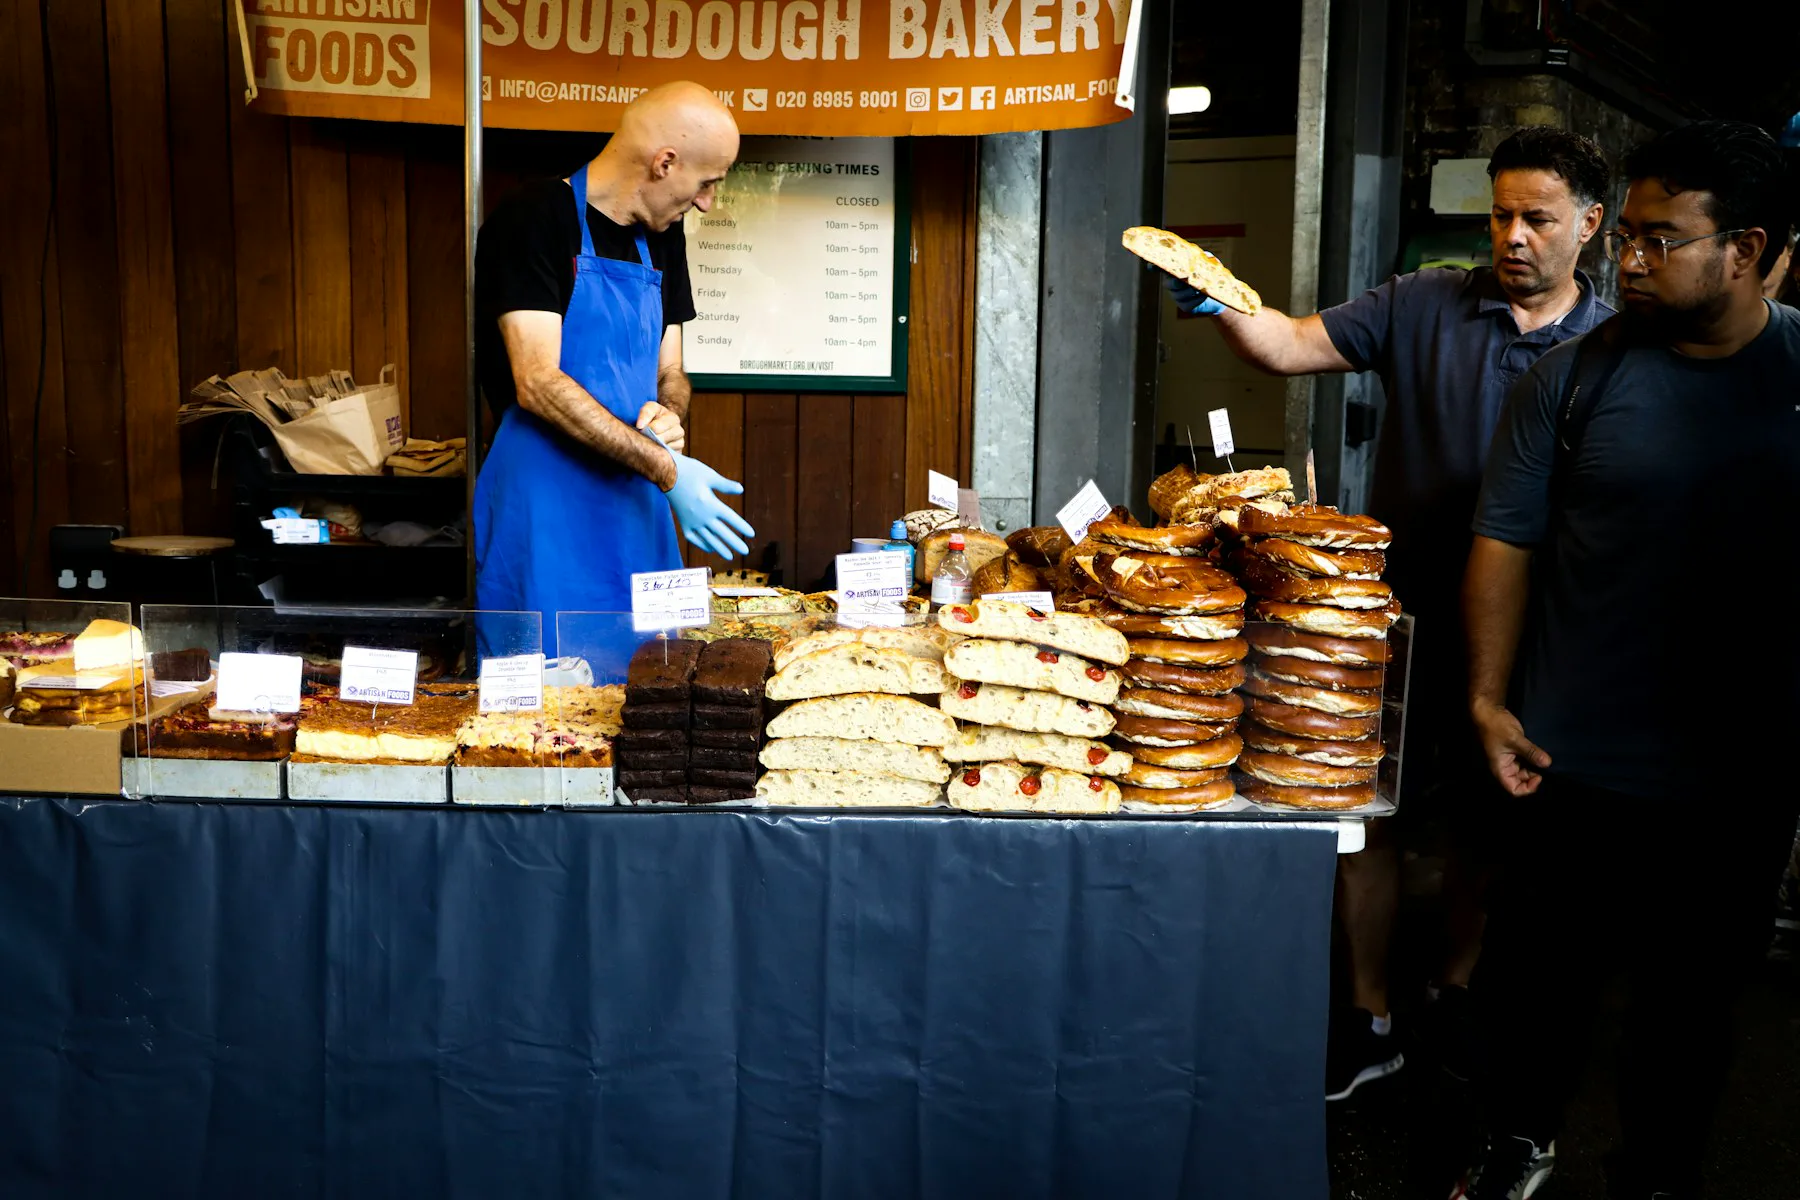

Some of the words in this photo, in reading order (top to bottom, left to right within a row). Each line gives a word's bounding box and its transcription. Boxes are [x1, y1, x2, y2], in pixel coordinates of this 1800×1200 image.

[482, 0, 860, 60] SOURDOUGH
[889, 0, 1131, 59] BAKERY
[255, 25, 417, 88] FOODS
[775, 91, 806, 108] 020
[812, 90, 853, 108] 8985
[859, 90, 898, 108] 8001
[766, 162, 832, 175] OPENING
[836, 164, 879, 176] TIMES
[836, 197, 879, 207] CLOSED
[699, 217, 737, 228] Tuesday
[825, 220, 849, 229] 10am
[859, 221, 879, 231] 5pm
[698, 241, 753, 253] Wednesday
[825, 244, 849, 253] 10am
[859, 245, 879, 254] 5pm
[698, 264, 743, 276] Thursday
[825, 268, 848, 277] 10am
[859, 269, 878, 278] 5pm
[697, 288, 727, 299] Friday
[825, 291, 848, 300] 10am
[858, 292, 877, 301] 5pm
[697, 312, 740, 323] Saturday
[828, 314, 848, 323] 9am
[858, 315, 877, 325] 5pm
[697, 335, 733, 346] Sunday
[824, 338, 847, 347] 10am
[857, 339, 877, 348] 4pm
[739, 360, 834, 371] BOROUGHMARKET.ORG.UK/VISIT
[882, 588, 903, 598] FOODS
[518, 696, 537, 706] FOODS
